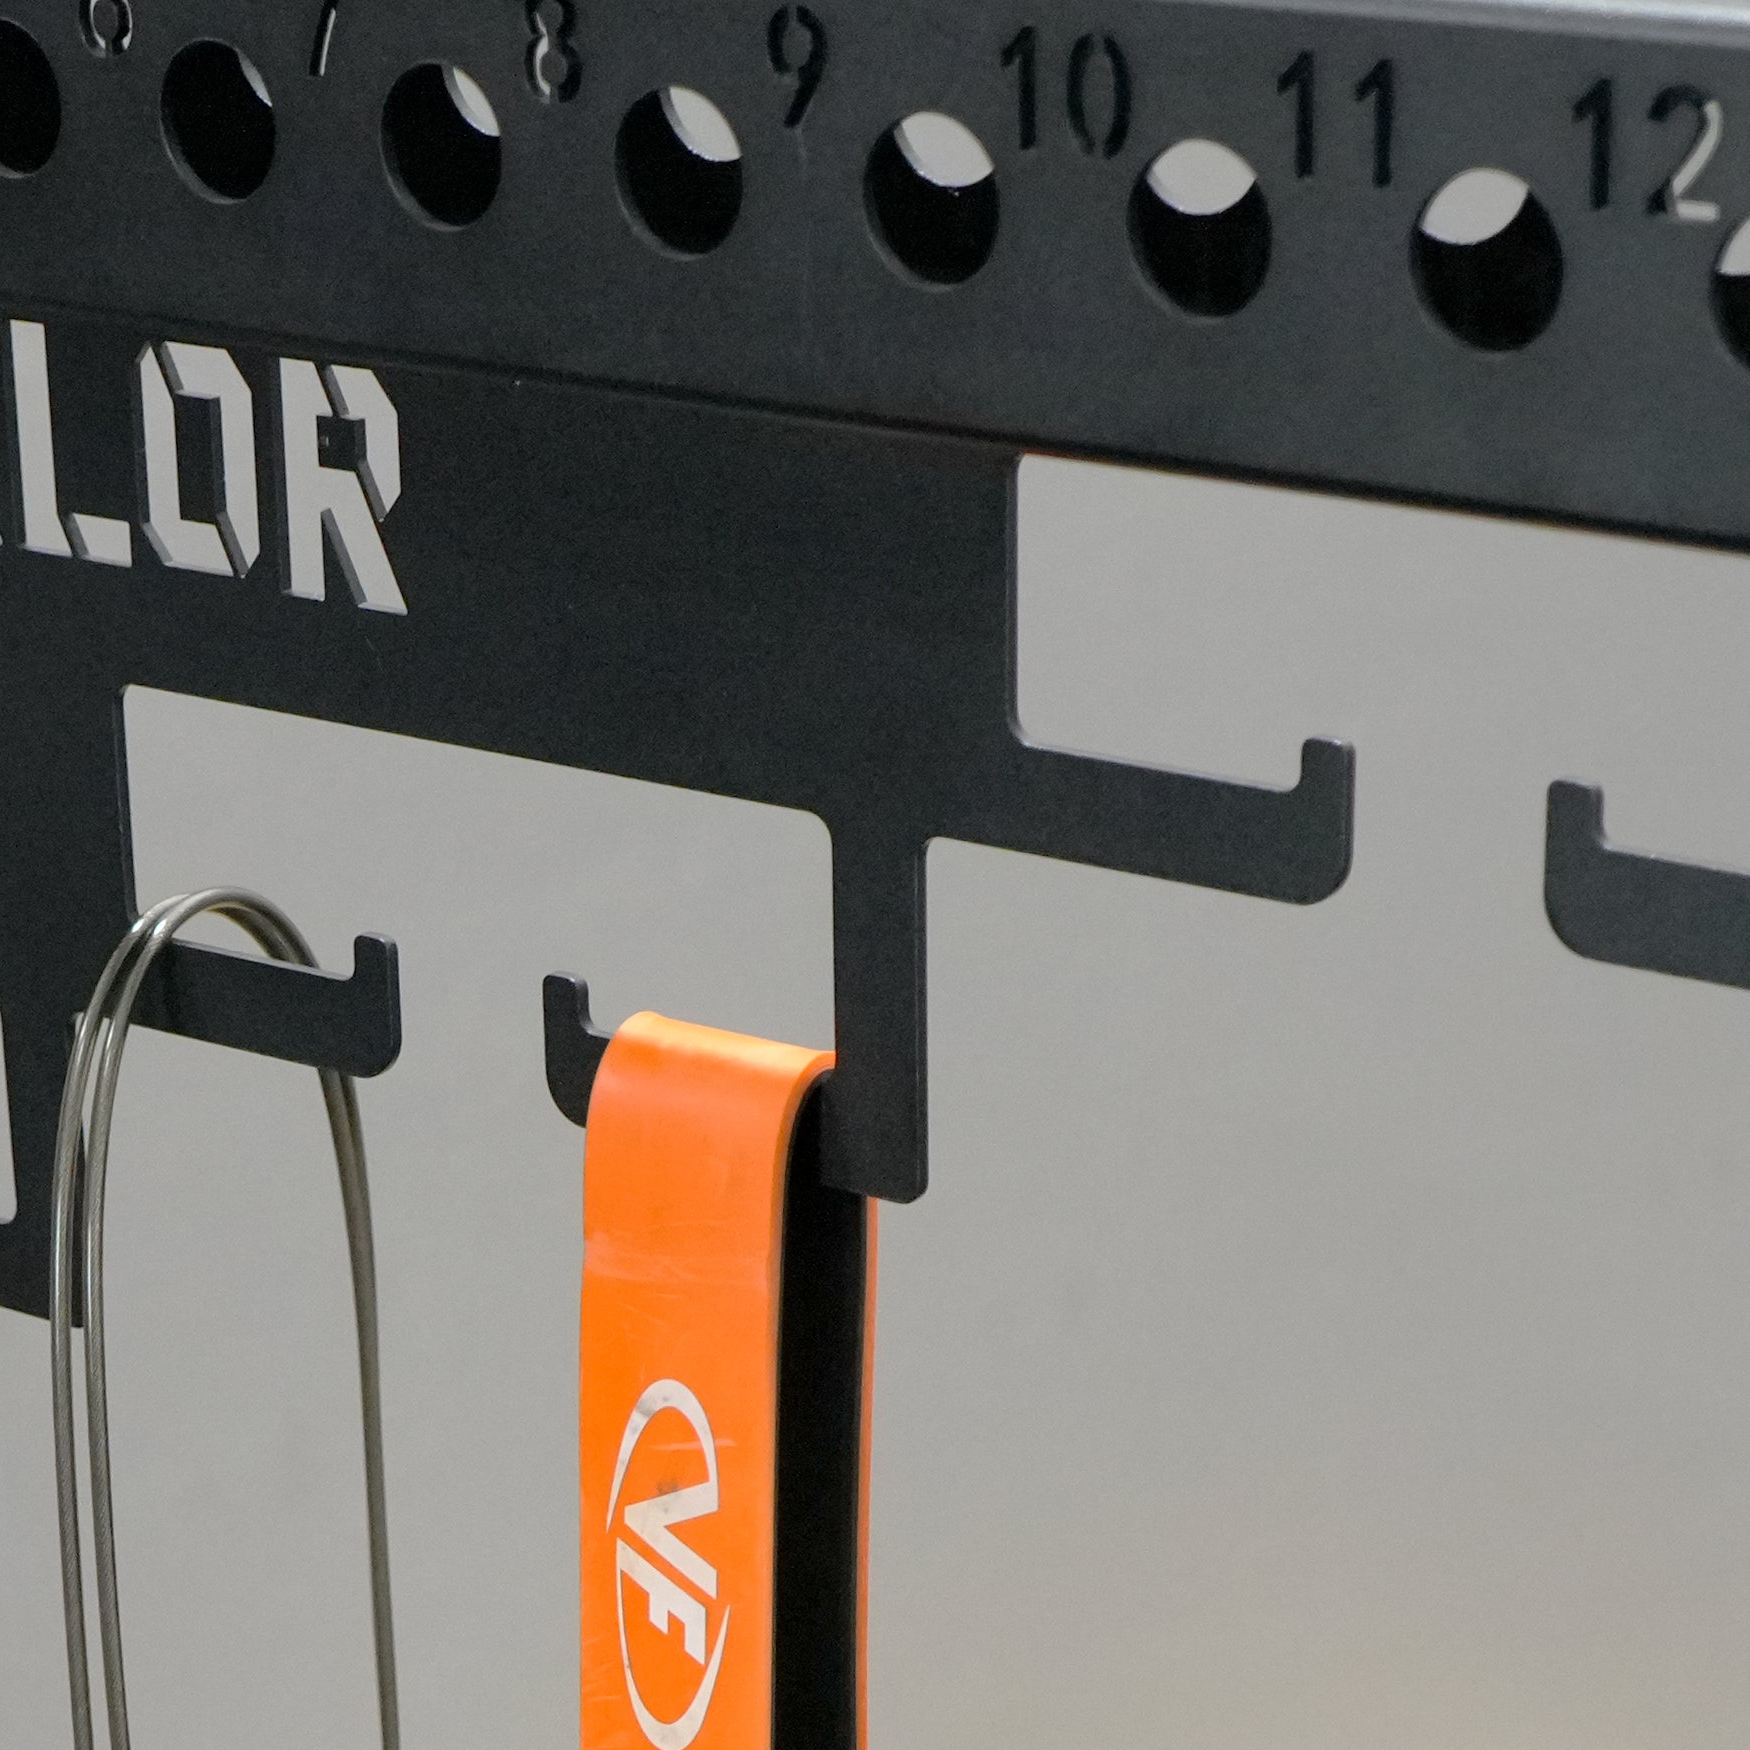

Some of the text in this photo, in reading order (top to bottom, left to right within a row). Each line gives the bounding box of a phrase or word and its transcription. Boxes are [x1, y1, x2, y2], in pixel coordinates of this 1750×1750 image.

[523, 0, 583, 104] 8
[766, 4, 828, 129] 9
[1000, 25, 1132, 159] 10
[1276, 50, 1394, 188] 11
[1570, 77, 1724, 222] 12
